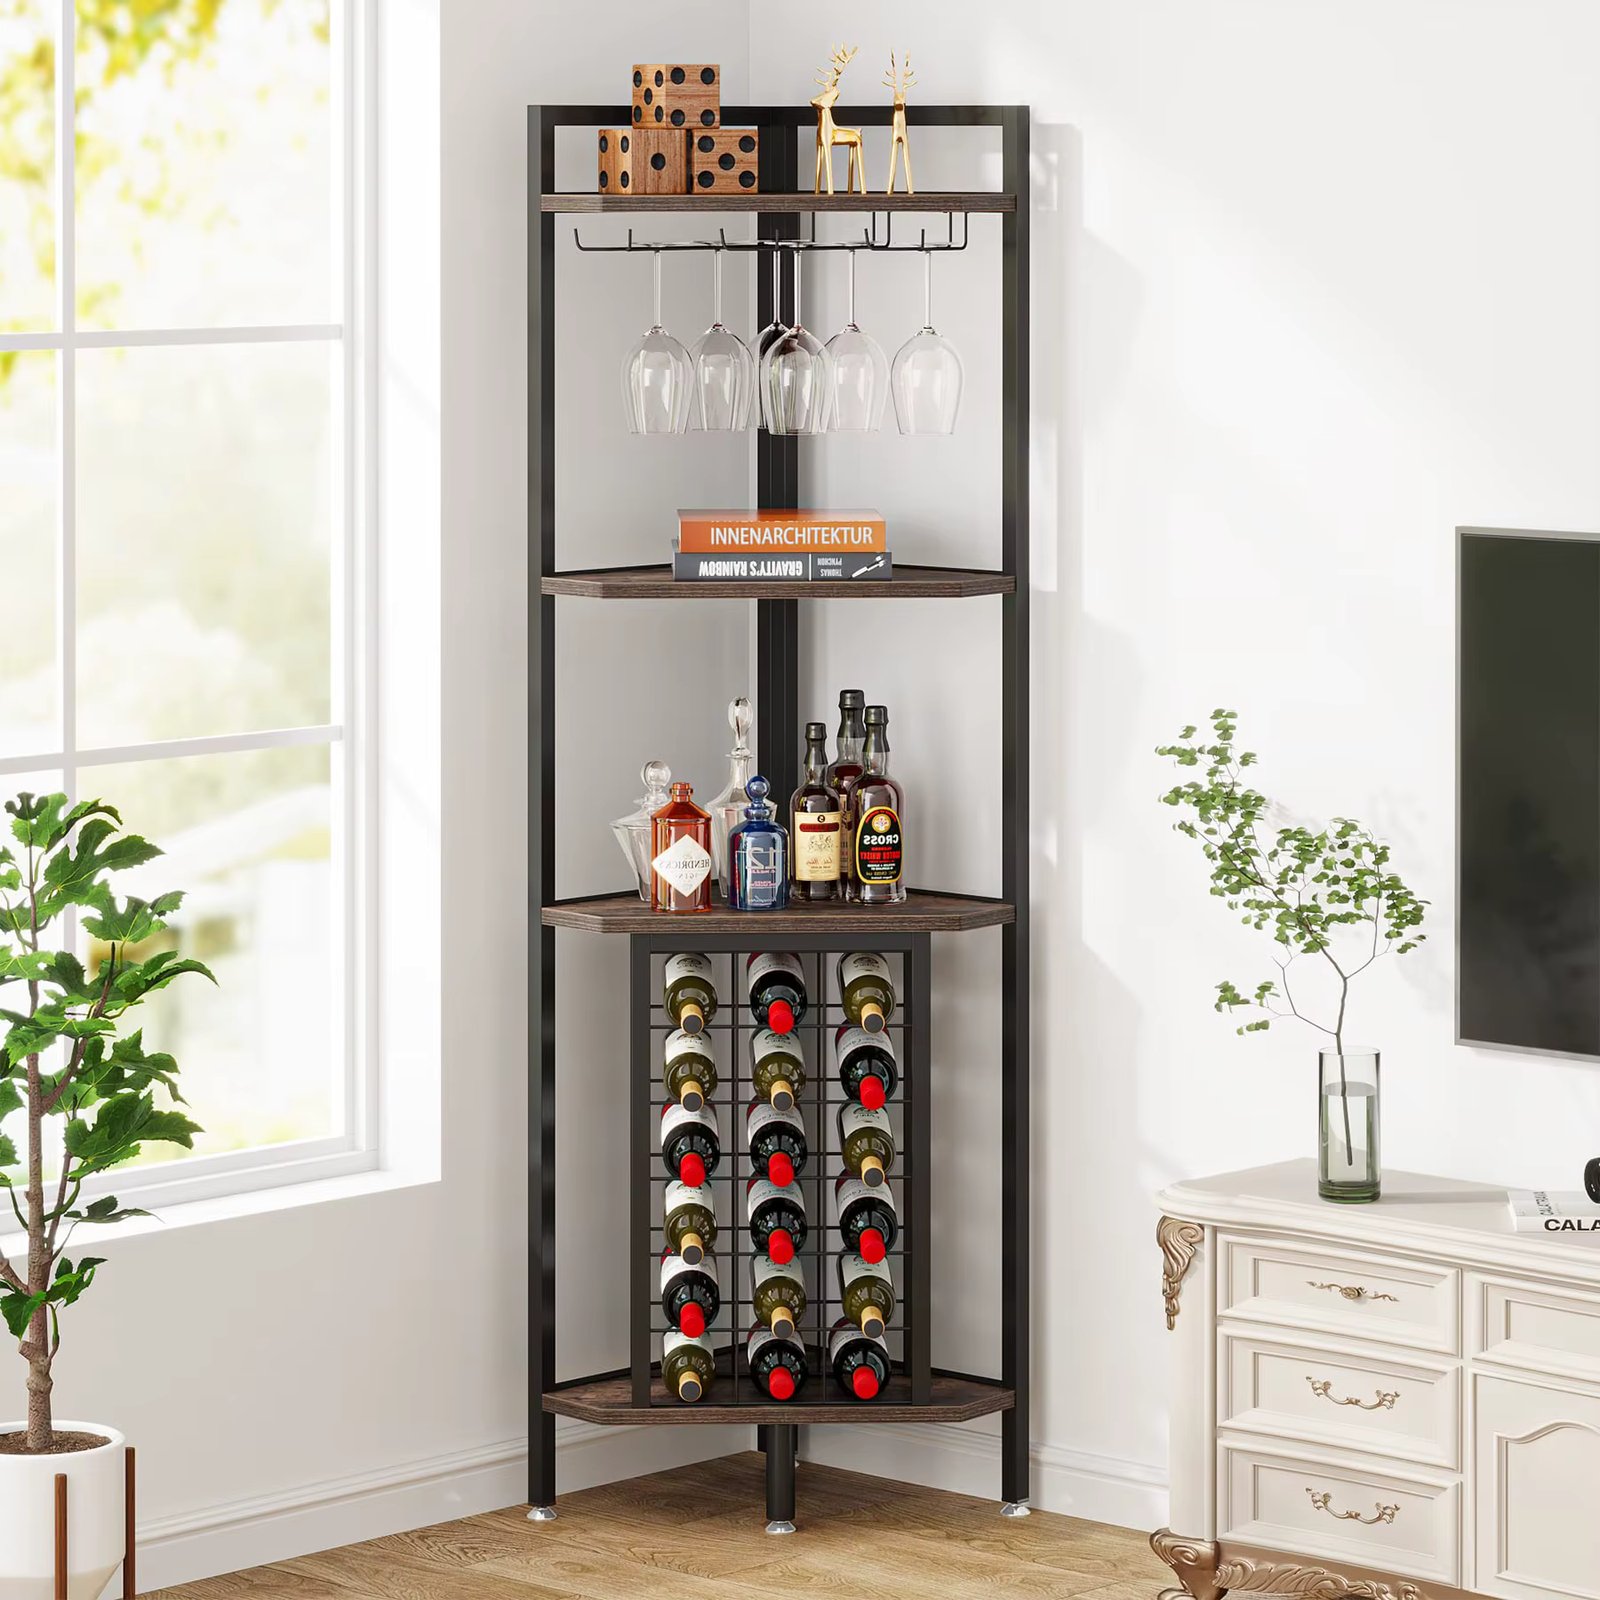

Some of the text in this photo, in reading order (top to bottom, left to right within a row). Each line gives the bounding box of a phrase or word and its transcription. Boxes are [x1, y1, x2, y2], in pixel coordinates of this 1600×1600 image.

[710, 527, 873, 545] INNENARCHITEKTUR
[817, 557, 843, 566] PYNCHON
[699, 560, 803, 577] GRAVITY'S RAINBOW
[820, 568, 843, 577] THOMAS
